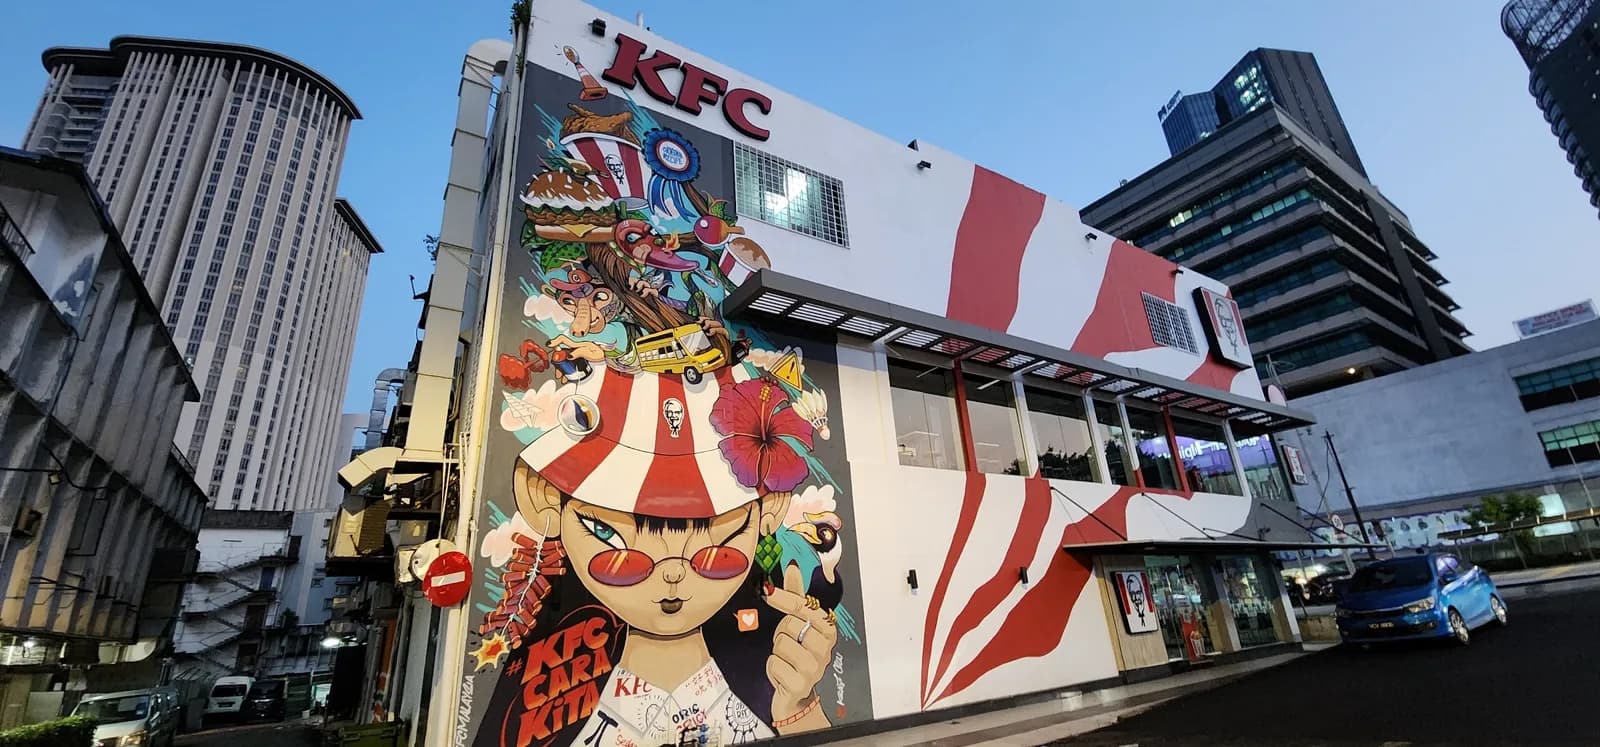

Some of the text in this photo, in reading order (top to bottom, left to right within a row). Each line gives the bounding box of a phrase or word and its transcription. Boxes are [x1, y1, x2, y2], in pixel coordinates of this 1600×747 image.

[602, 33, 772, 141] KFC
[456, 675, 475, 747] FCMALAYSIA
[523, 647, 612, 710] CARA
